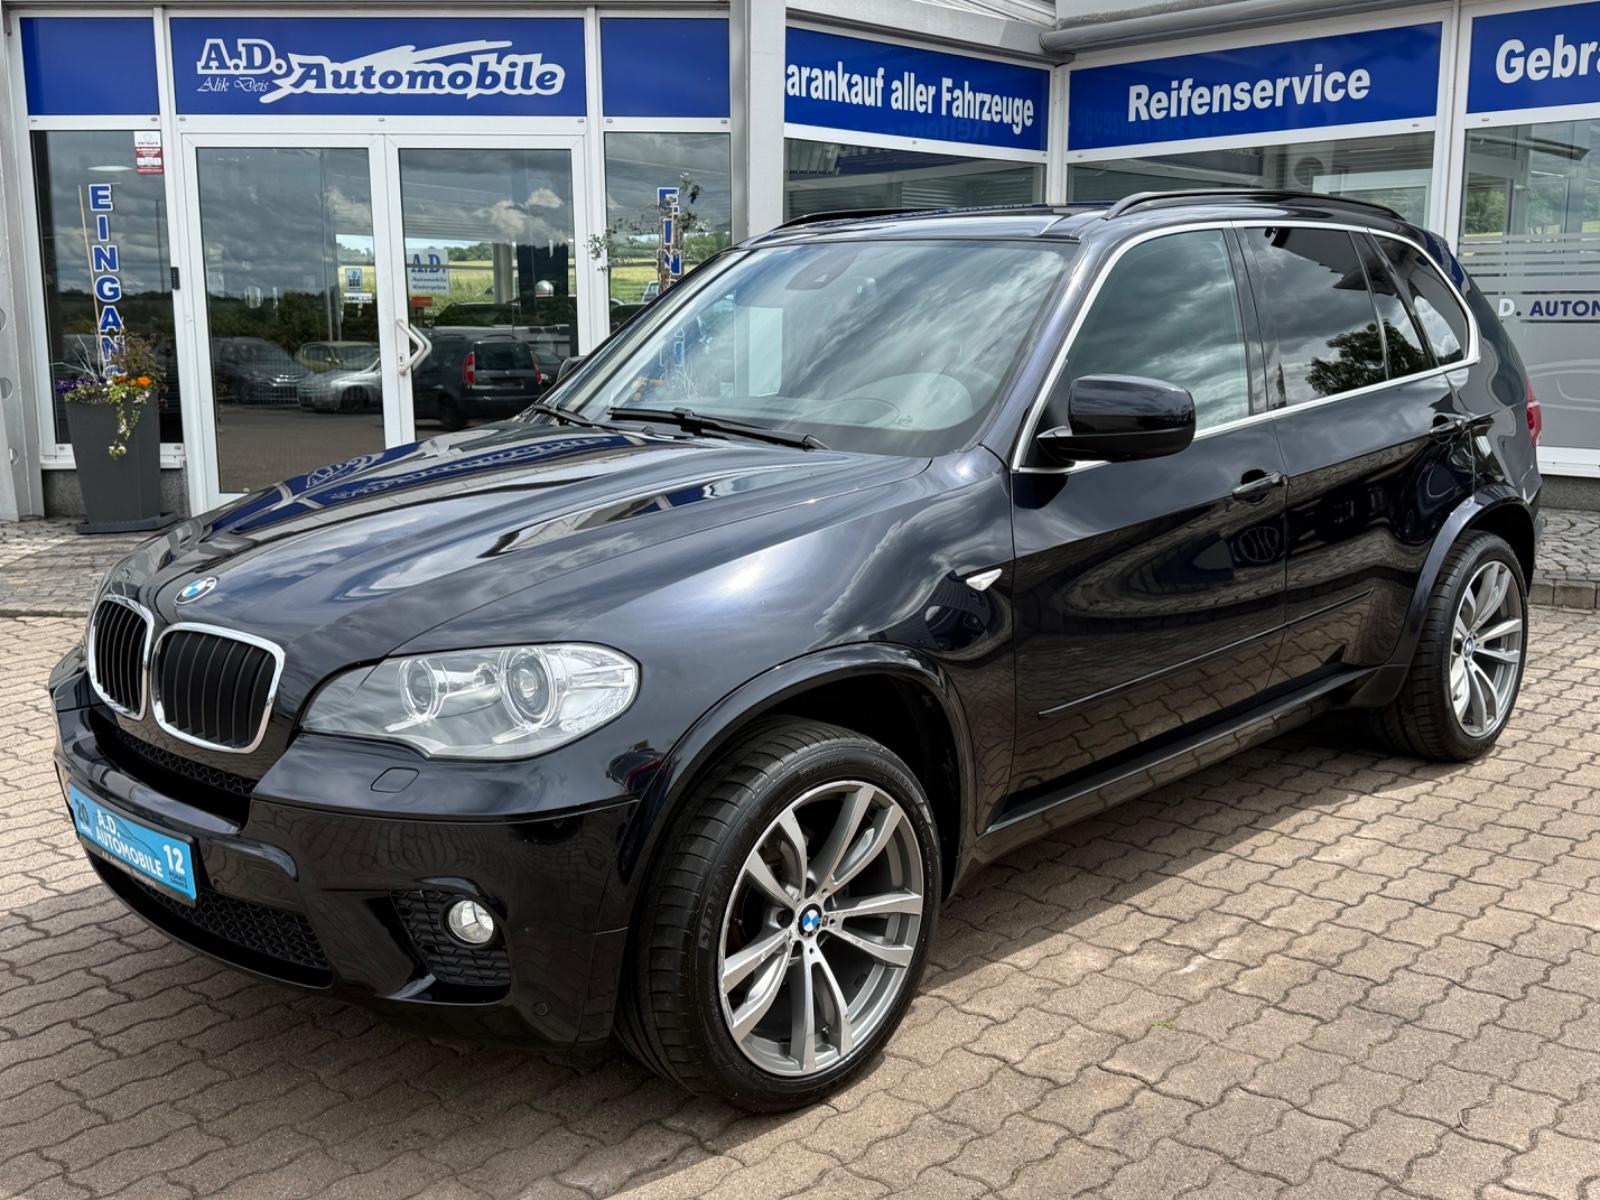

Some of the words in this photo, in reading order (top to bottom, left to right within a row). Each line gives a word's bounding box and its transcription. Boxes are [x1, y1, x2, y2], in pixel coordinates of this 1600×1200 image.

[197, 38, 289, 77] A.D.
[286, 52, 565, 98] Automobile
[1495, 34, 1600, 84] Gebr
[786, 61, 885, 107] arankauf
[890, 72, 936, 113] aller
[941, 77, 1034, 135] Fahrzeuge
[1127, 63, 1371, 122] Reifenservice
[96, 826, 164, 878] AUTOMOBILE
[163, 844, 185, 875] 12
